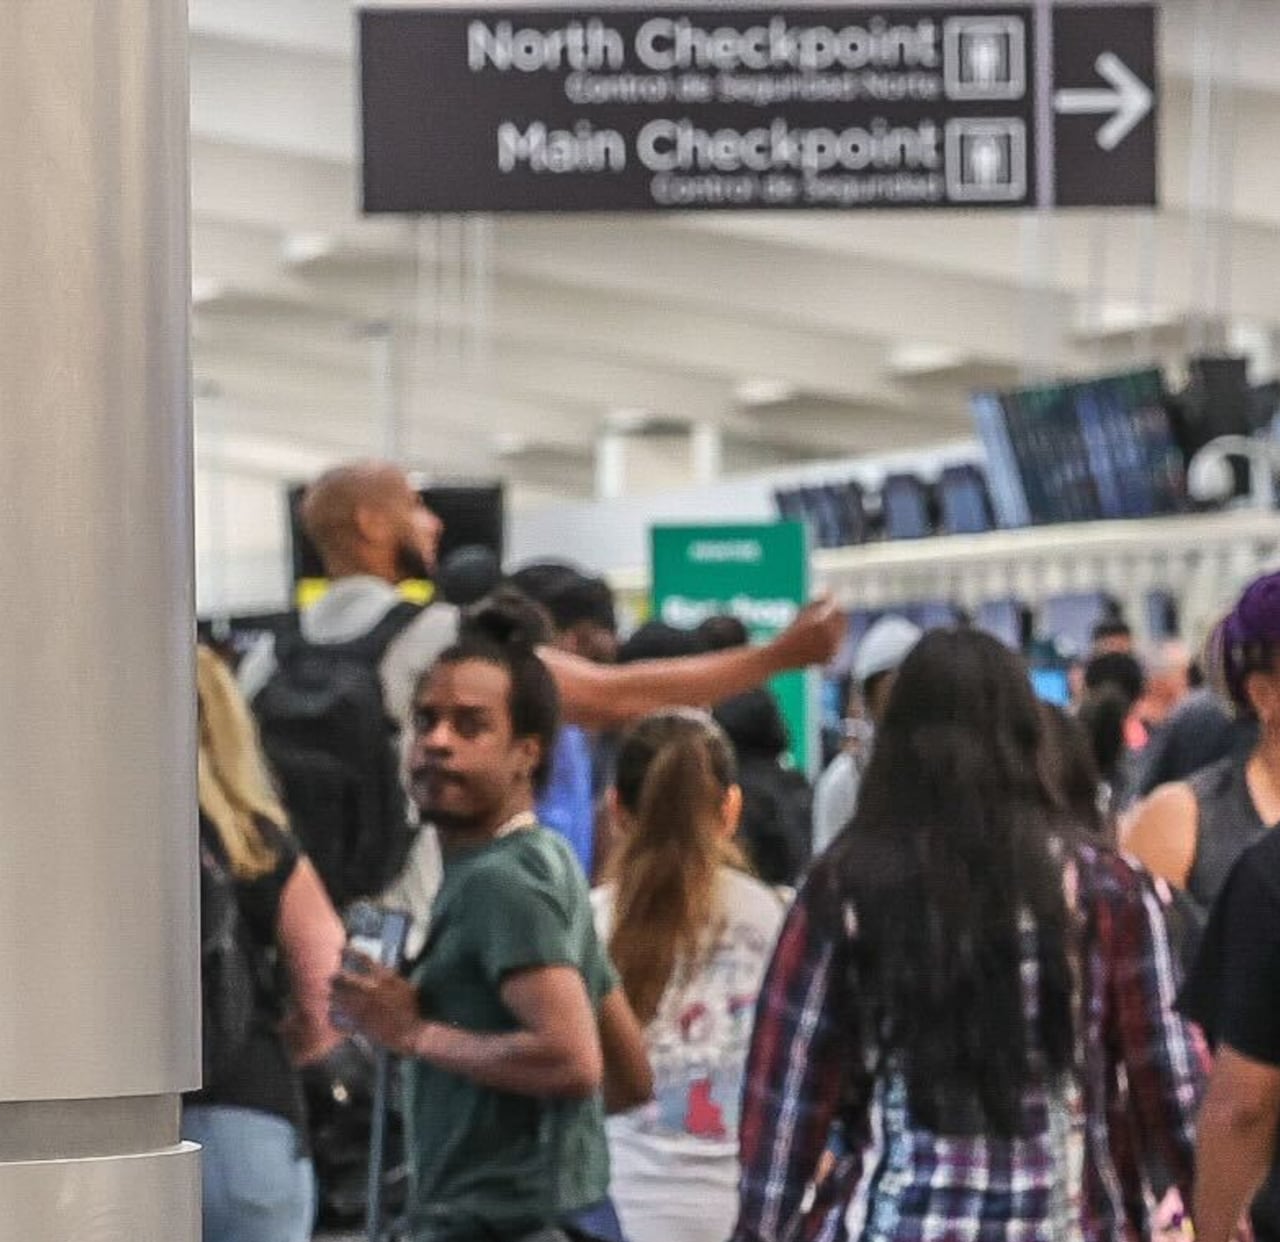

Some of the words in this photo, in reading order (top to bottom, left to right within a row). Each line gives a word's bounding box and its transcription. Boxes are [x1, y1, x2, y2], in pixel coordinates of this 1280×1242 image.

[467, 18, 625, 72] North
[635, 15, 939, 76] Checkpoint
[565, 71, 671, 104] Control
[674, 71, 712, 103] de
[497, 119, 627, 173] Main
[636, 117, 939, 179] Checkpoint
[650, 171, 756, 205] Control
[761, 173, 800, 203] de
